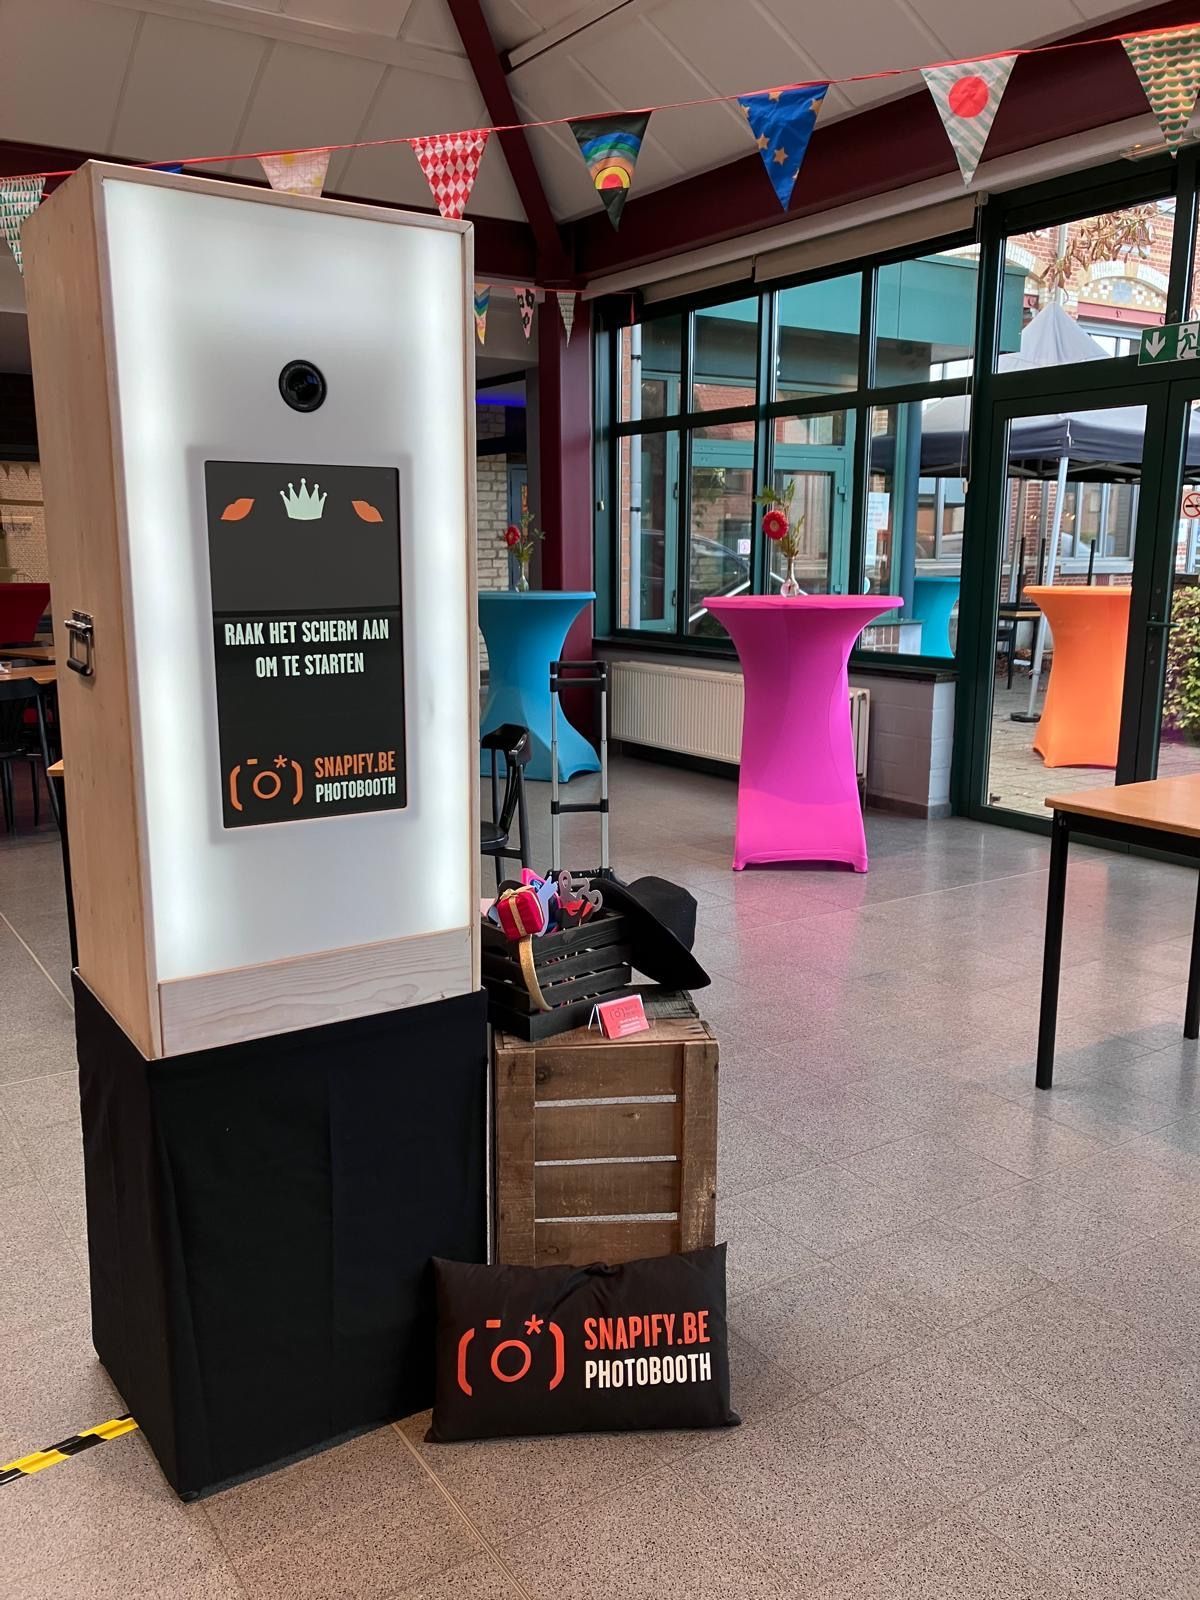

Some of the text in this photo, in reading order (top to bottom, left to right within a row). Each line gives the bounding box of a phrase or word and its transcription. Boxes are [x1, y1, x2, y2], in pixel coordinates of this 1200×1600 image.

[224, 619, 389, 646] RAAK HET SCHERM AAN
[256, 652, 365, 678] OM TE STARTEN
[314, 751, 396, 778] SNAPIFY.BE
[316, 777, 396, 803] PHOTOBOOTH
[584, 1311, 710, 1350] SNAPIFY.BE
[585, 1353, 712, 1389] PHOTOBOOTH
